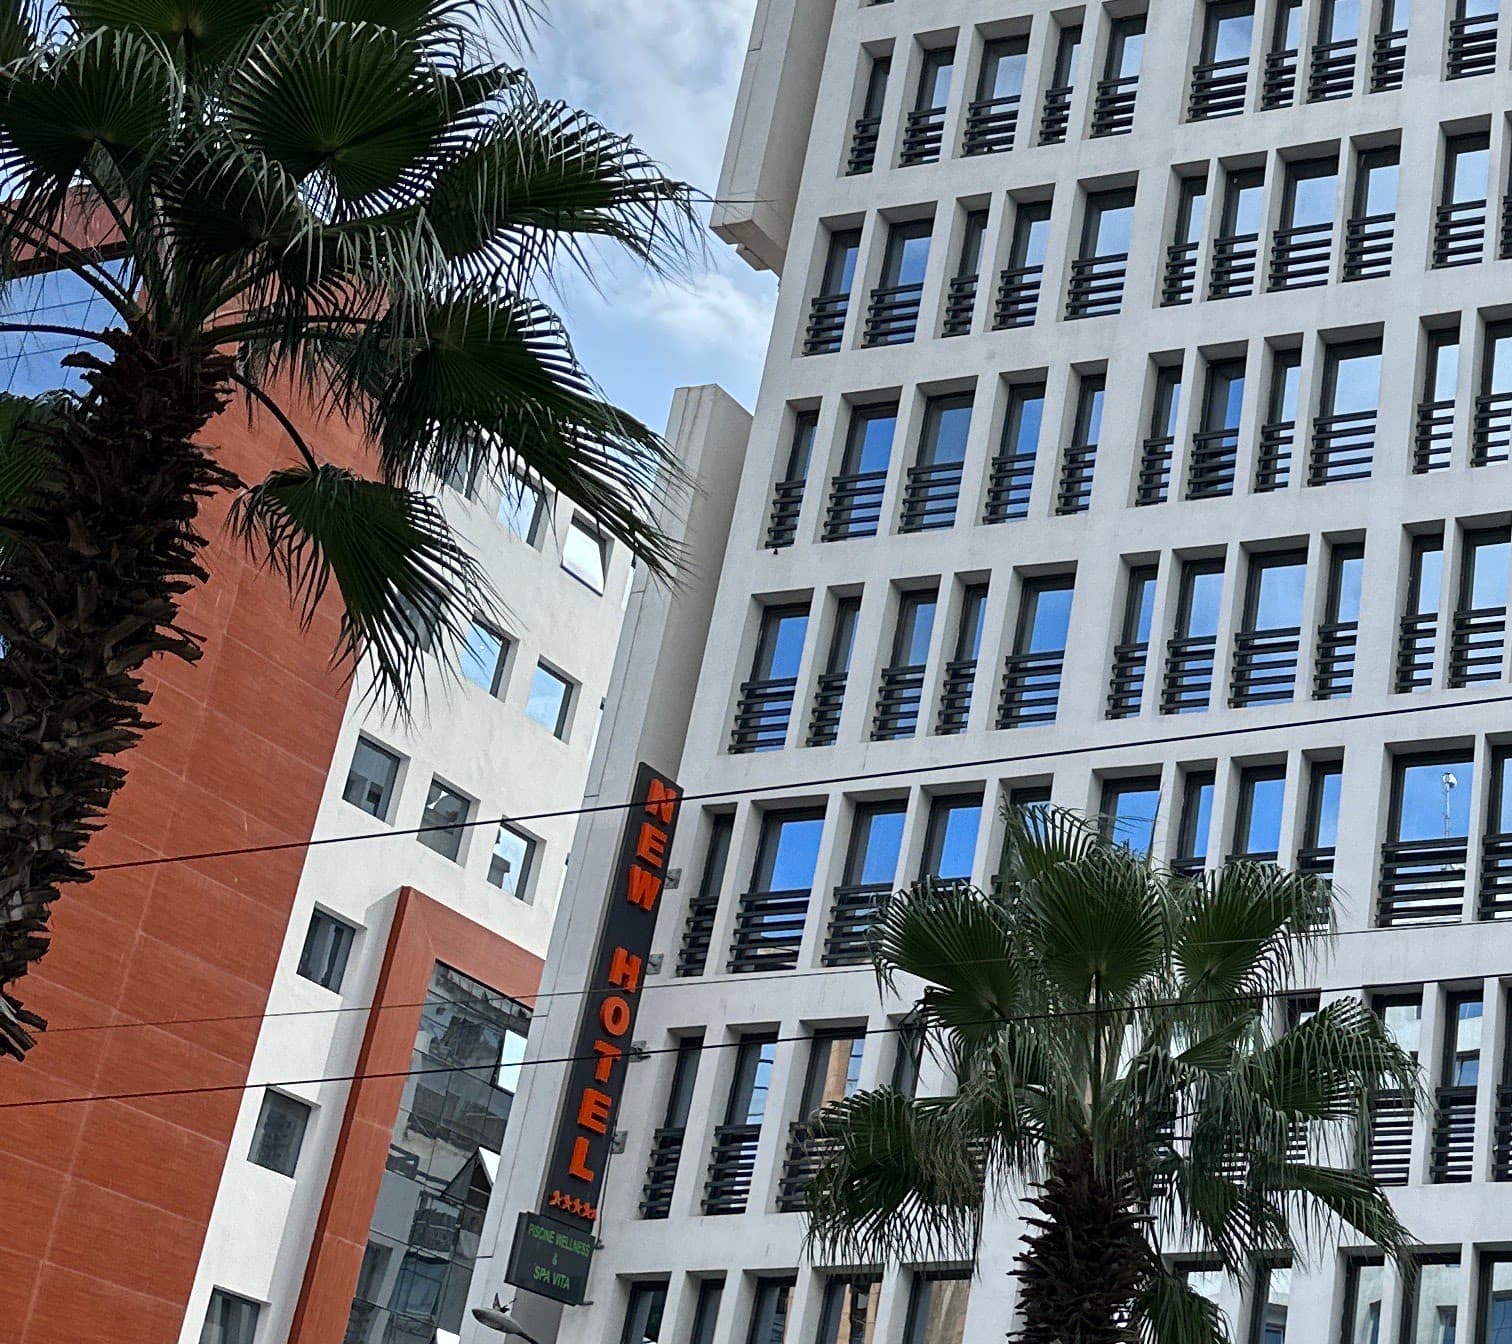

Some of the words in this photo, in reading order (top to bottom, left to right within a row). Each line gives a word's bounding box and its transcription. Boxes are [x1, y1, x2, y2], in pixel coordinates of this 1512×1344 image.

[627, 777, 678, 913] NEW
[567, 945, 642, 1184] HOTEL
[528, 1223, 555, 1244] PISCINE
[556, 1233, 591, 1258] WELLNESS
[533, 1264, 550, 1284] SPA
[553, 1271, 570, 1290] VITA
